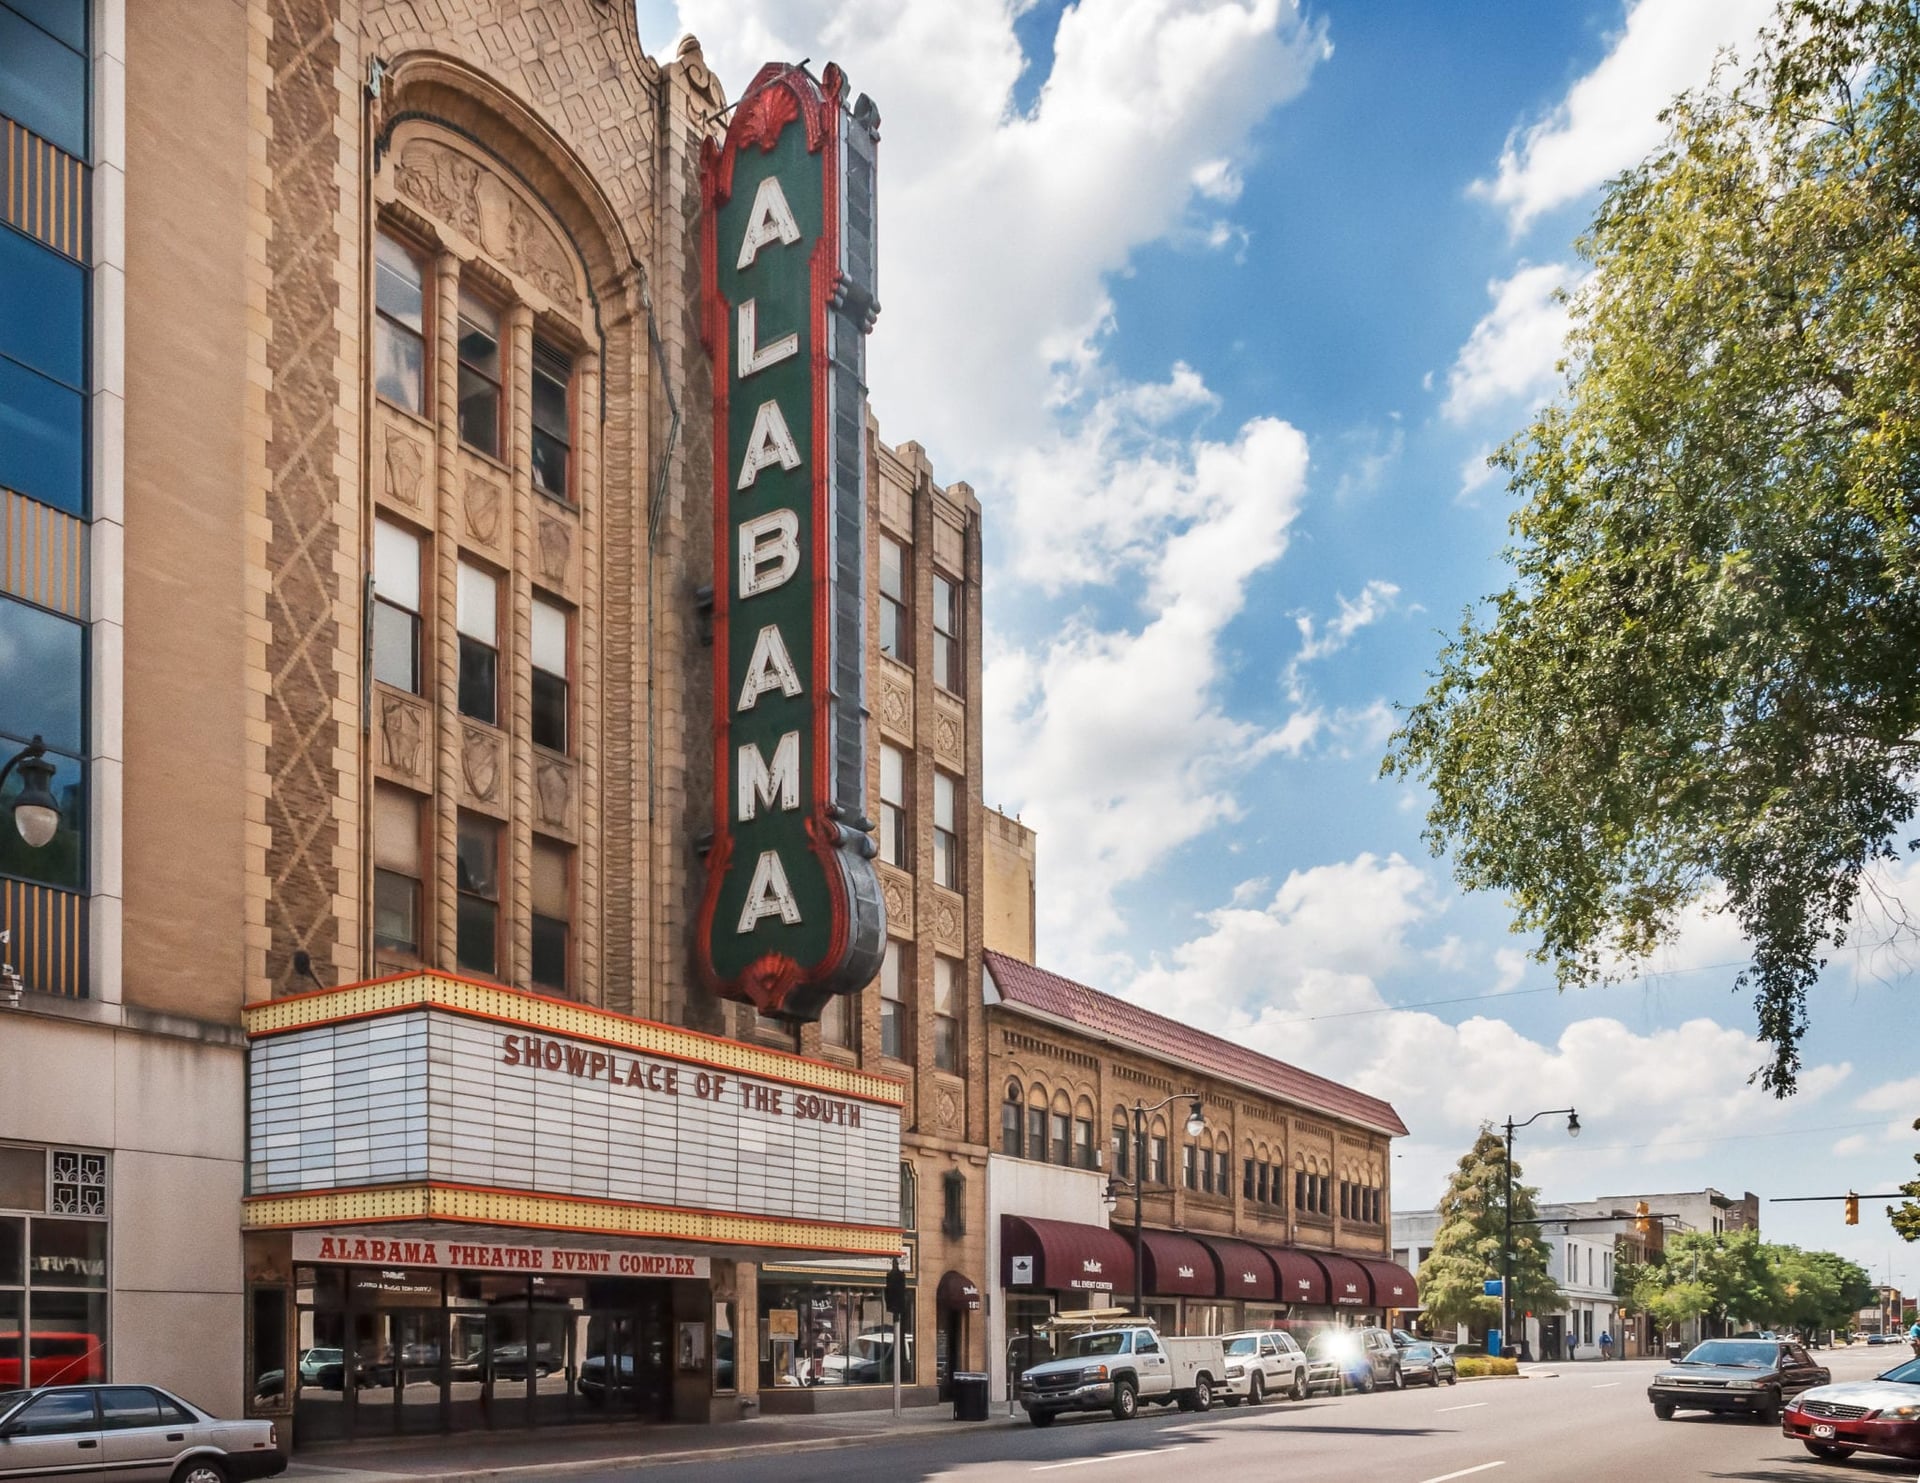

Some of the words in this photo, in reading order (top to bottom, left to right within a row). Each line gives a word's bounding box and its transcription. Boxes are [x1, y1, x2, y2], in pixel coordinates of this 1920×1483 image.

[736, 175, 802, 935] ALABAMA
[503, 1034, 678, 1096] SHOWPLACE
[695, 1072, 726, 1101] OF
[740, 1082, 783, 1115] THE
[794, 1093, 861, 1129] SOUTH
[318, 1237, 438, 1265] ALABAMA
[449, 1244, 542, 1269] THEATRE
[552, 1250, 611, 1272] EVENT
[619, 1254, 695, 1276] COMPLEX
[1081, 1280, 1095, 1288] EVENT
[1096, 1281, 1112, 1290] CENTER
